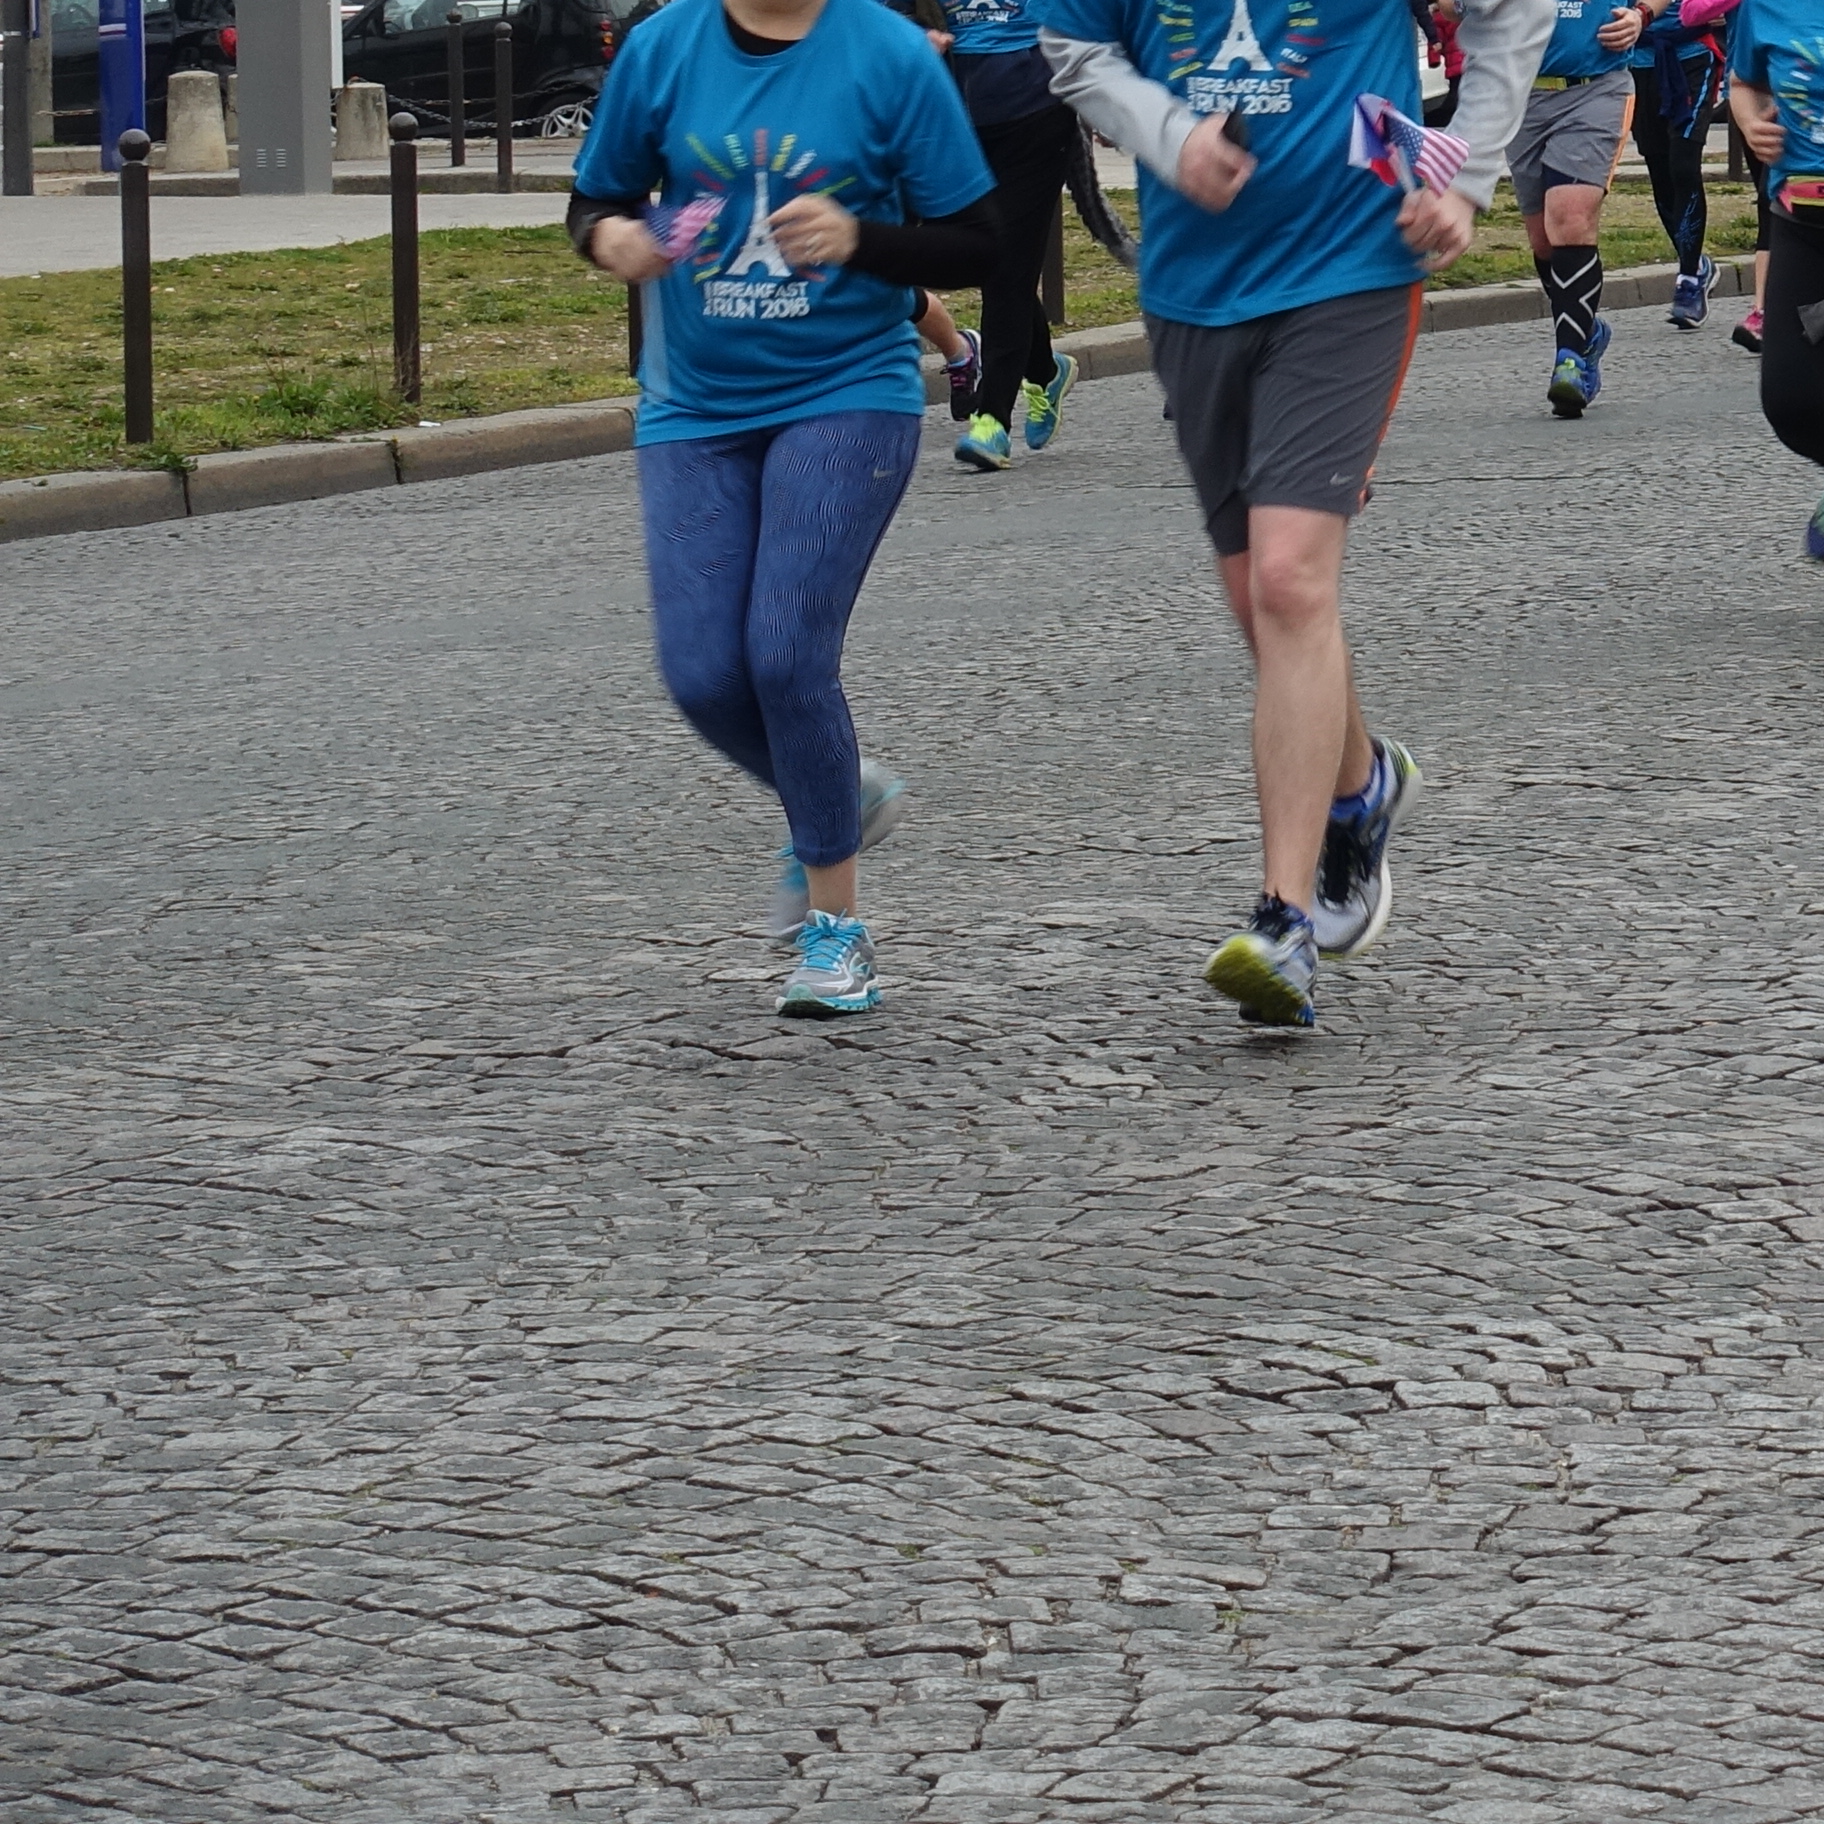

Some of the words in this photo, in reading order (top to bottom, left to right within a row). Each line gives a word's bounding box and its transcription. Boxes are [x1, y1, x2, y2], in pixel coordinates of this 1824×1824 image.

[1196, 76, 1294, 94] BREAKFAST
[1196, 93, 1239, 114] RUN
[1241, 94, 1293, 114] 2016
[712, 280, 809, 298] BREAKFAST
[712, 297, 756, 319] RUN
[759, 298, 810, 318] 2016
